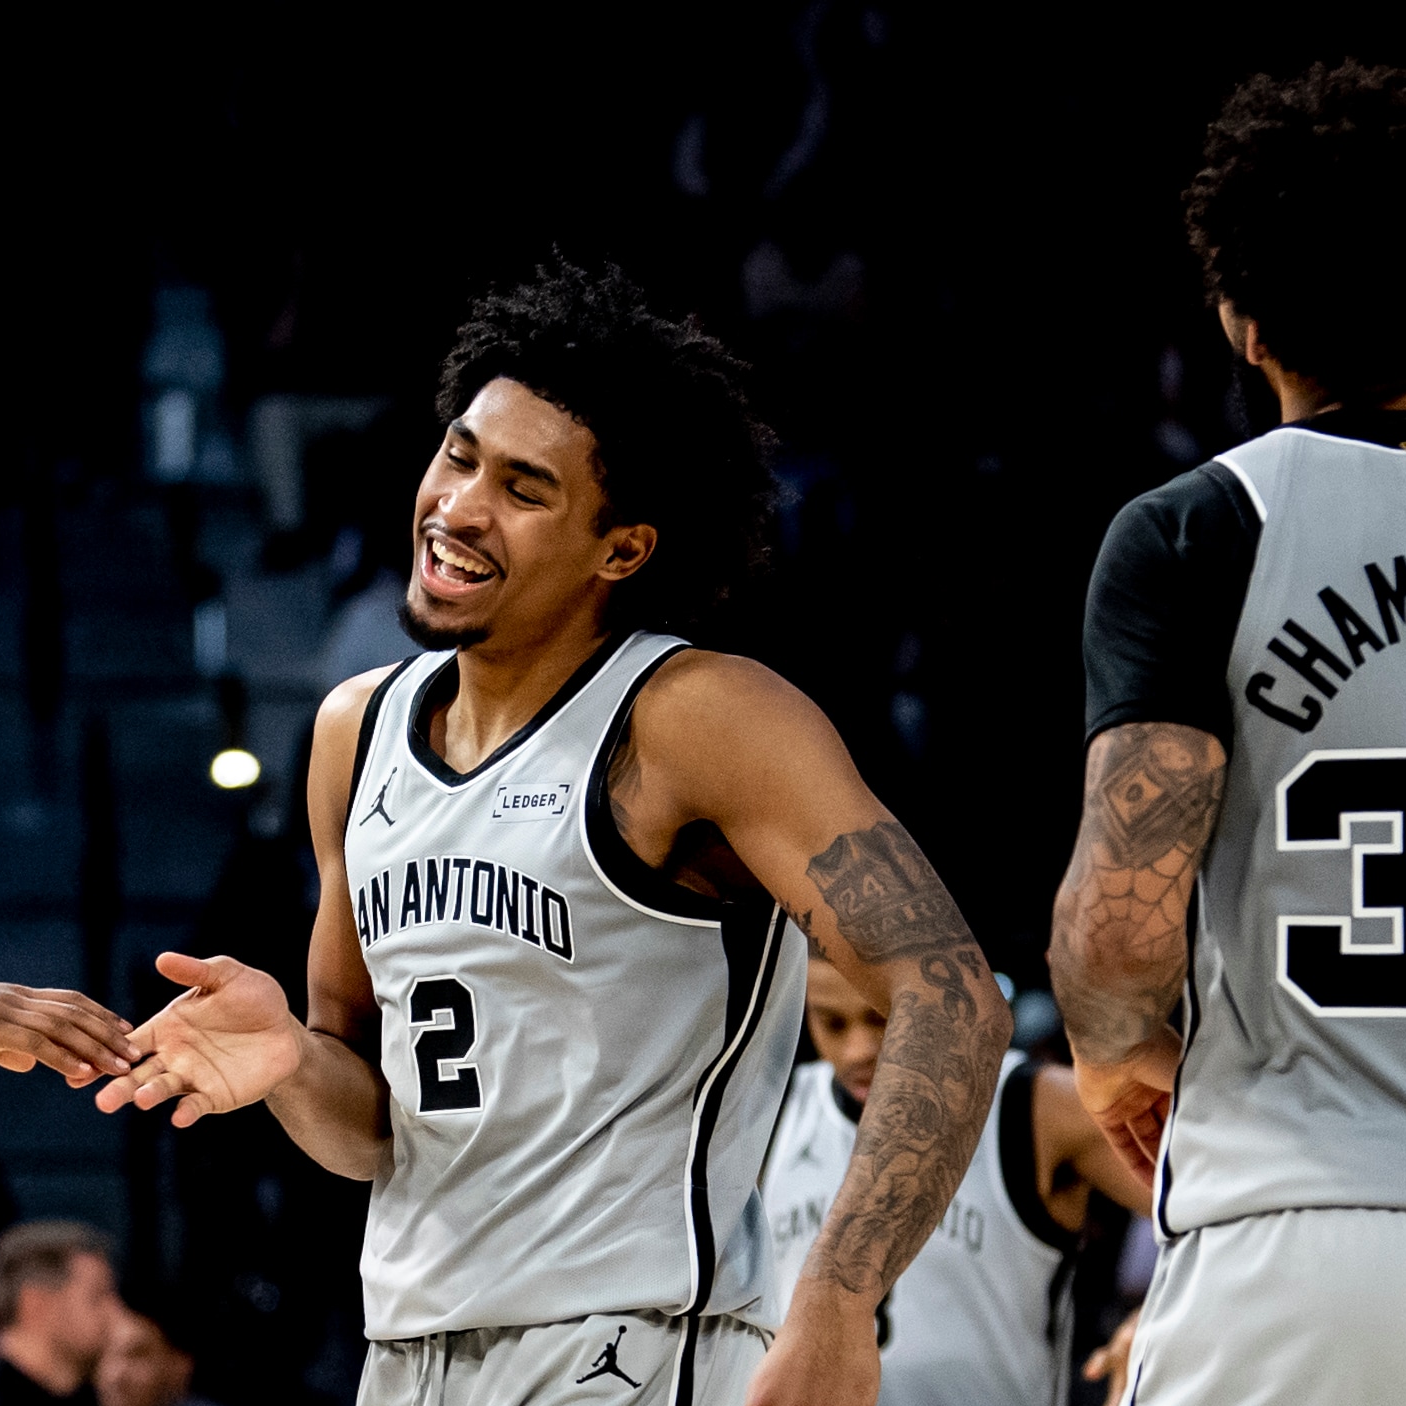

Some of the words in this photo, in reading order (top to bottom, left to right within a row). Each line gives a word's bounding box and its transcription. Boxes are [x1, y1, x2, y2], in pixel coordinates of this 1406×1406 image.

[502, 794, 557, 809] LEDGER
[357, 867, 391, 951] AN
[398, 857, 575, 964] ANTONIO
[408, 974, 484, 1117] 2
